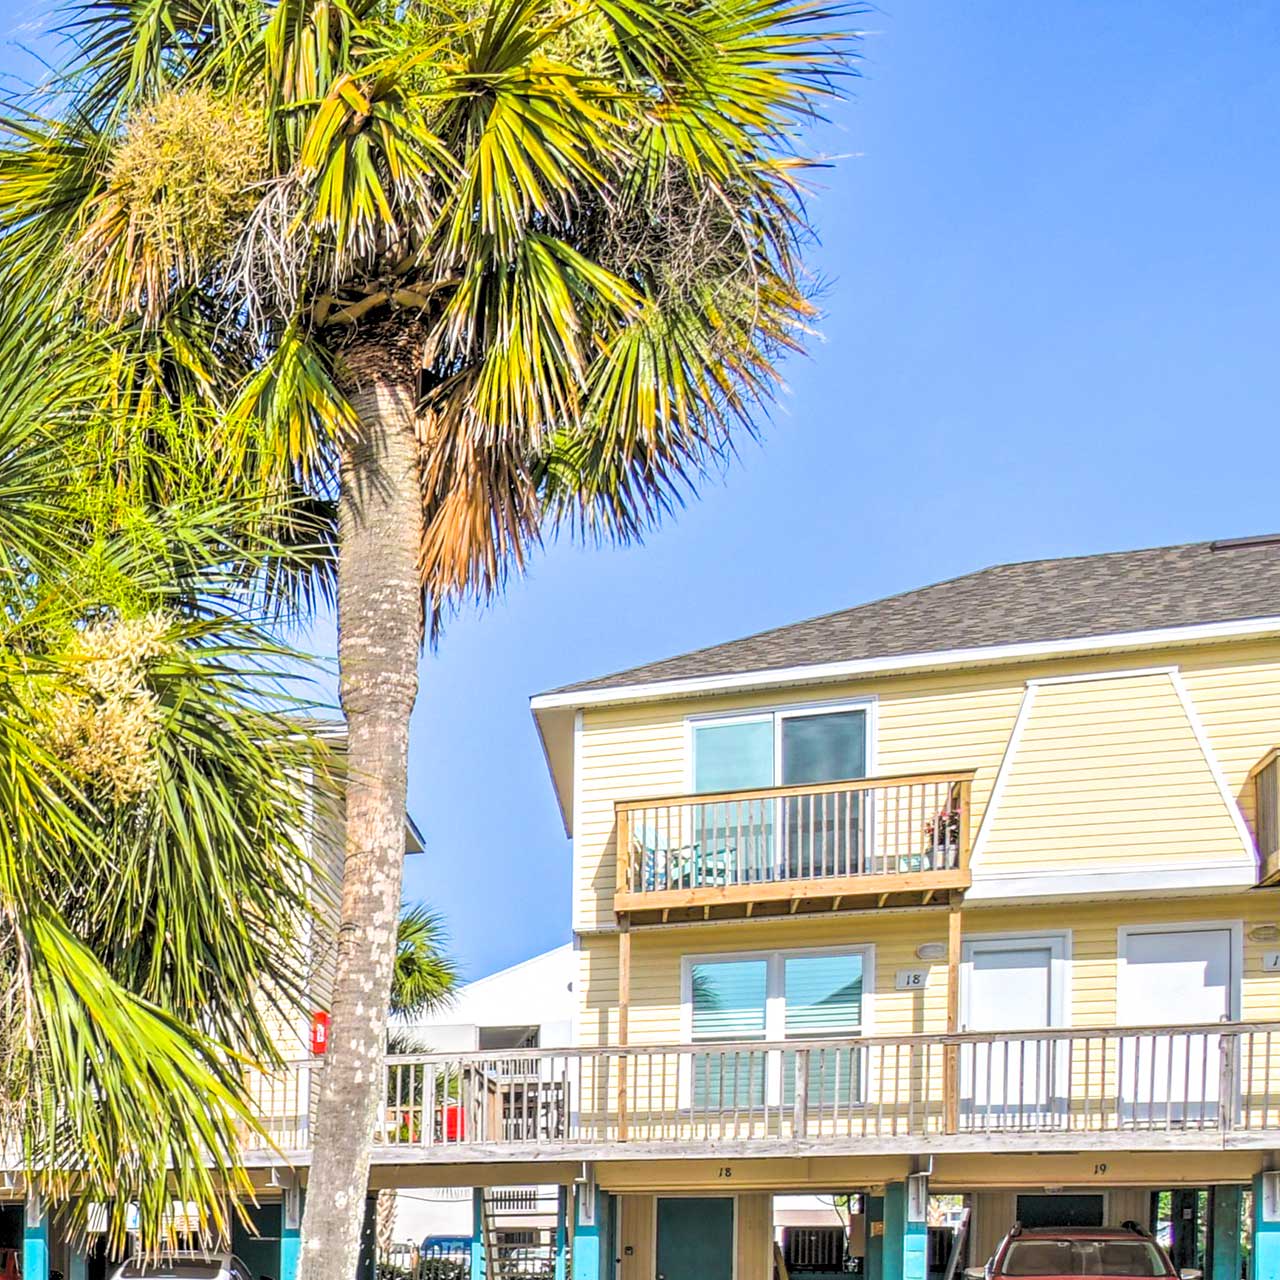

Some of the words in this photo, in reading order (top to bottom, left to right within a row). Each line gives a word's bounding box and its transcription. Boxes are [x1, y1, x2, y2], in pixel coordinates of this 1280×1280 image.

[906, 974, 921, 986] 18
[718, 1166, 732, 1178] 18
[1094, 1163, 1107, 1176] 19
